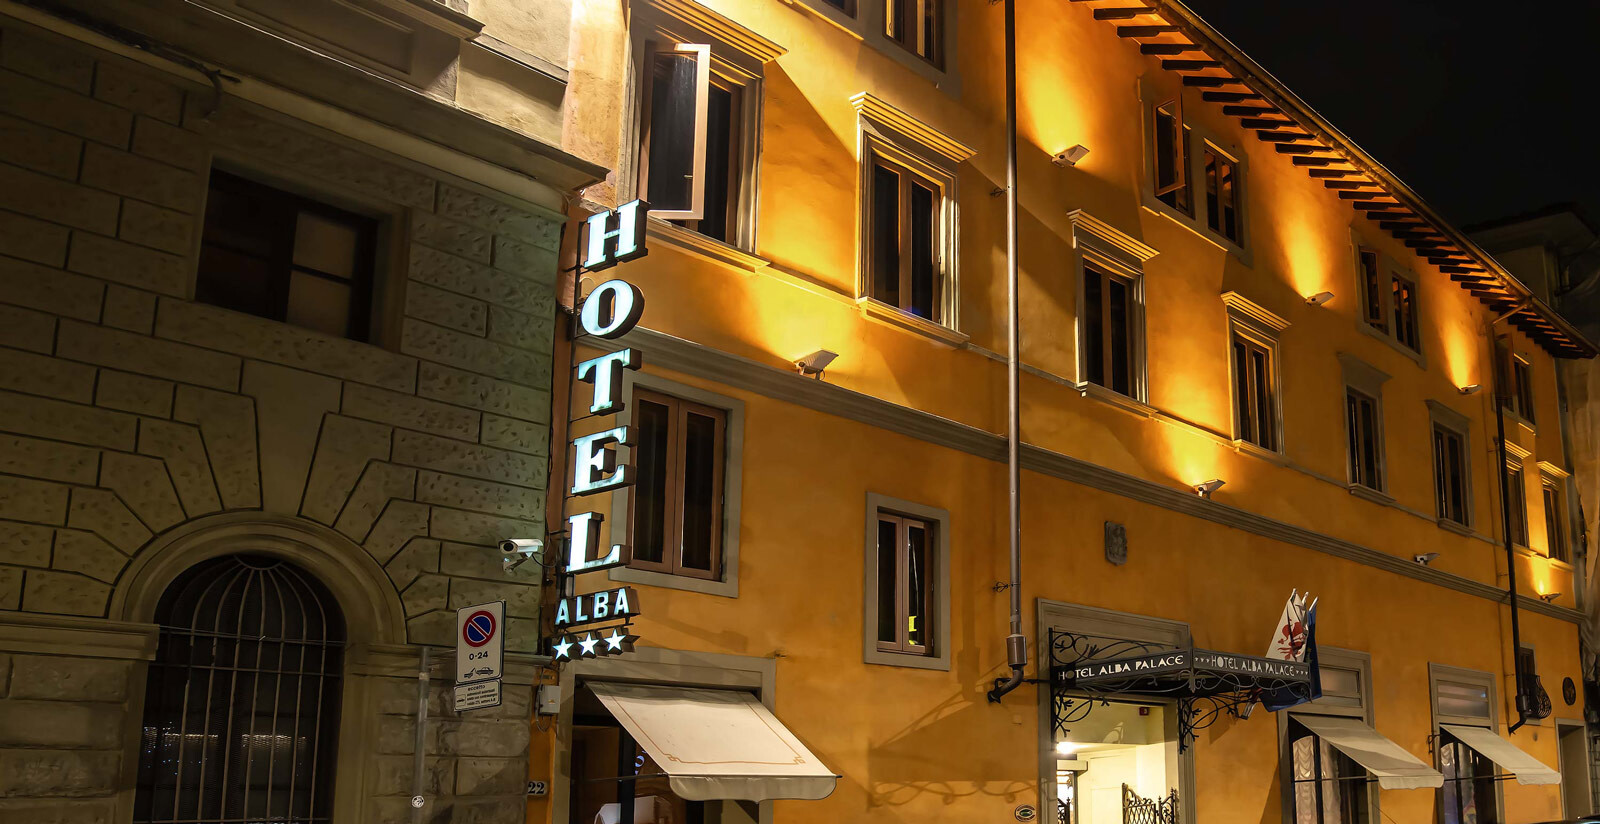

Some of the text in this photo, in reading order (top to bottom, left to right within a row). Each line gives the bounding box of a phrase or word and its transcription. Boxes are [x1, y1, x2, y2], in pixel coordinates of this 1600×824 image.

[566, 199, 641, 572] HOTEL
[555, 588, 630, 625] ALBA
[469, 651, 488, 660] 0-24
[1212, 656, 1295, 676] HOTEL ALBA PALACE
[1058, 655, 1183, 680] HOTEL ALBA PALACE
[528, 782, 544, 794] 22
